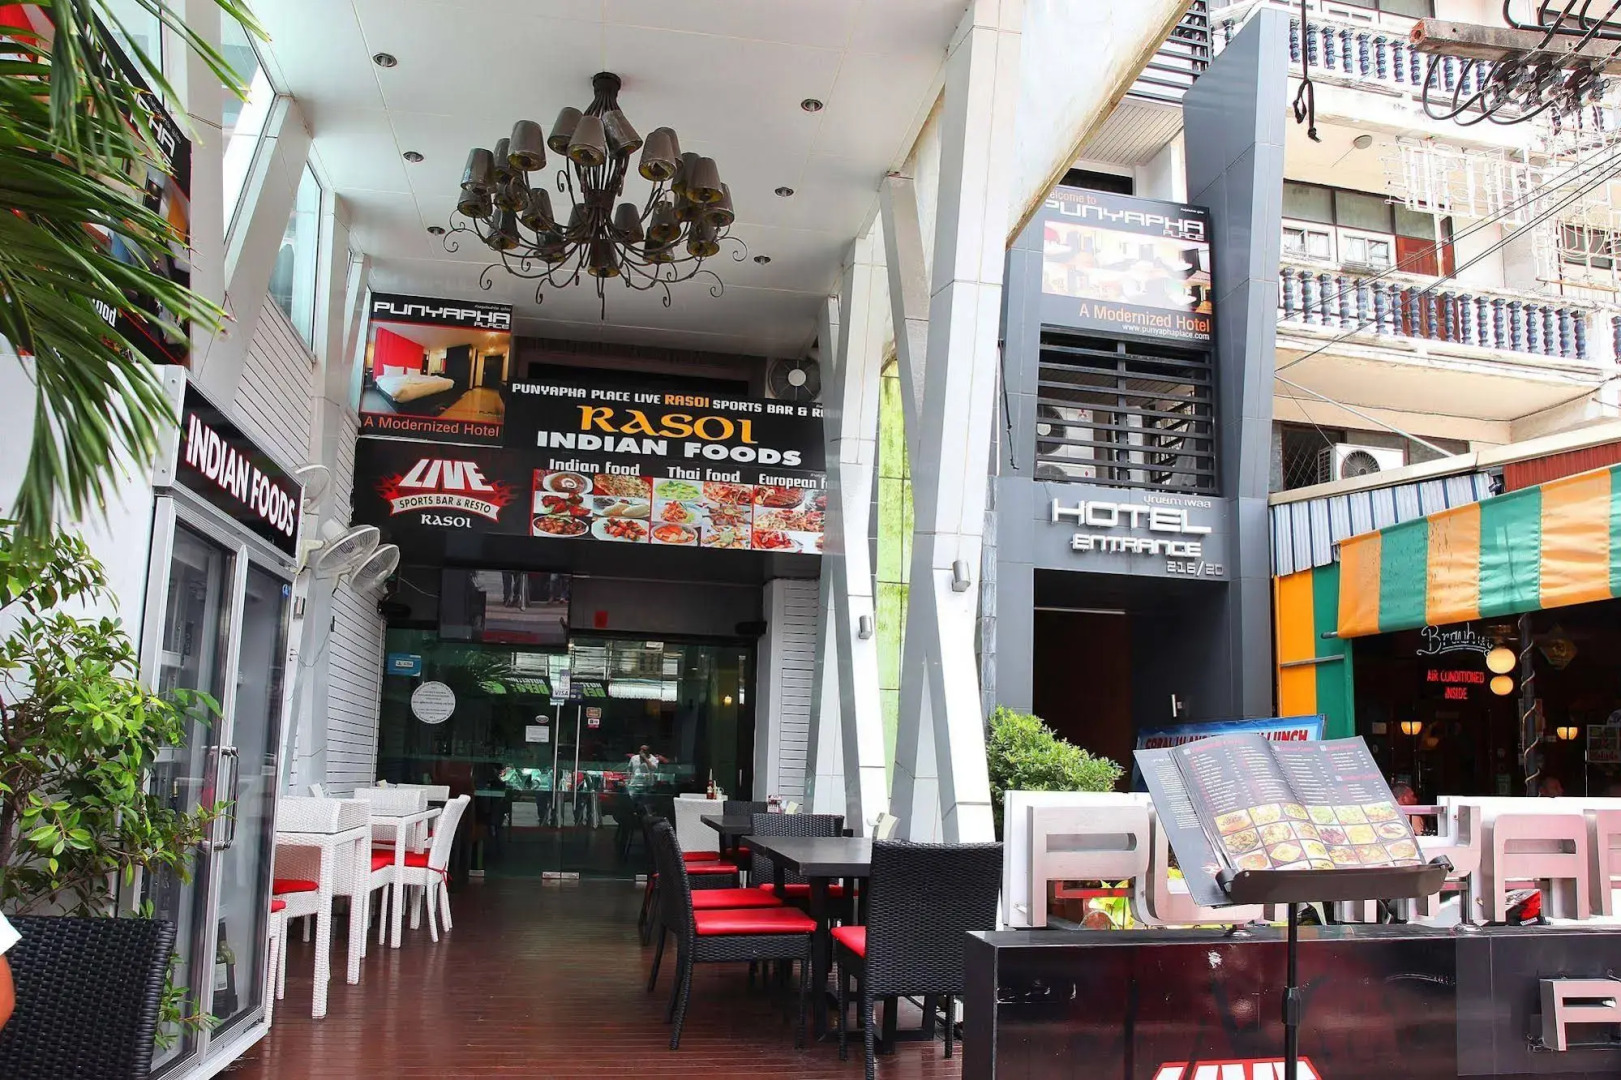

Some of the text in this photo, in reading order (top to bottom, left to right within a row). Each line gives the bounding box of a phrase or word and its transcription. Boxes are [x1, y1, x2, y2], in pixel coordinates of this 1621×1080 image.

[1046, 189, 1097, 205] elcome to
[1162, 229, 1205, 242] PLACE
[373, 301, 510, 324] PUNYAPHA
[1079, 303, 1211, 333] A Modernized Hotel
[473, 321, 510, 330] PLACE
[1122, 323, 1210, 341] www.punyaphaplace.com
[511, 382, 588, 398] PUNYAPHA
[590, 388, 631, 402] PLACE
[633, 391, 661, 405] LIVE
[664, 393, 710, 408] RASOI
[712, 398, 763, 414] SPORTS
[766, 402, 794, 416] BAR
[797, 406, 808, 417] &
[364, 415, 500, 438] A Modernized Hotel
[577, 404, 759, 445] RASOI
[536, 431, 803, 467] INDIAN FOODS
[186, 413, 296, 537] INDIAN FOODS
[398, 458, 495, 492] LIVE
[549, 458, 641, 477] Indian food
[666, 465, 741, 483] Thai food
[758, 473, 817, 489] European
[399, 495, 491, 513] SPORTS BAR & RESTO
[420, 514, 473, 529] RASOI
[1051, 498, 1212, 534] HOTEL
[1072, 533, 1202, 557] ENTRANCE
[1166, 560, 1224, 577] 216/20
[1426, 669, 1485, 684] AIR CONDITIONED
[1444, 686, 1469, 700] INSIDE
